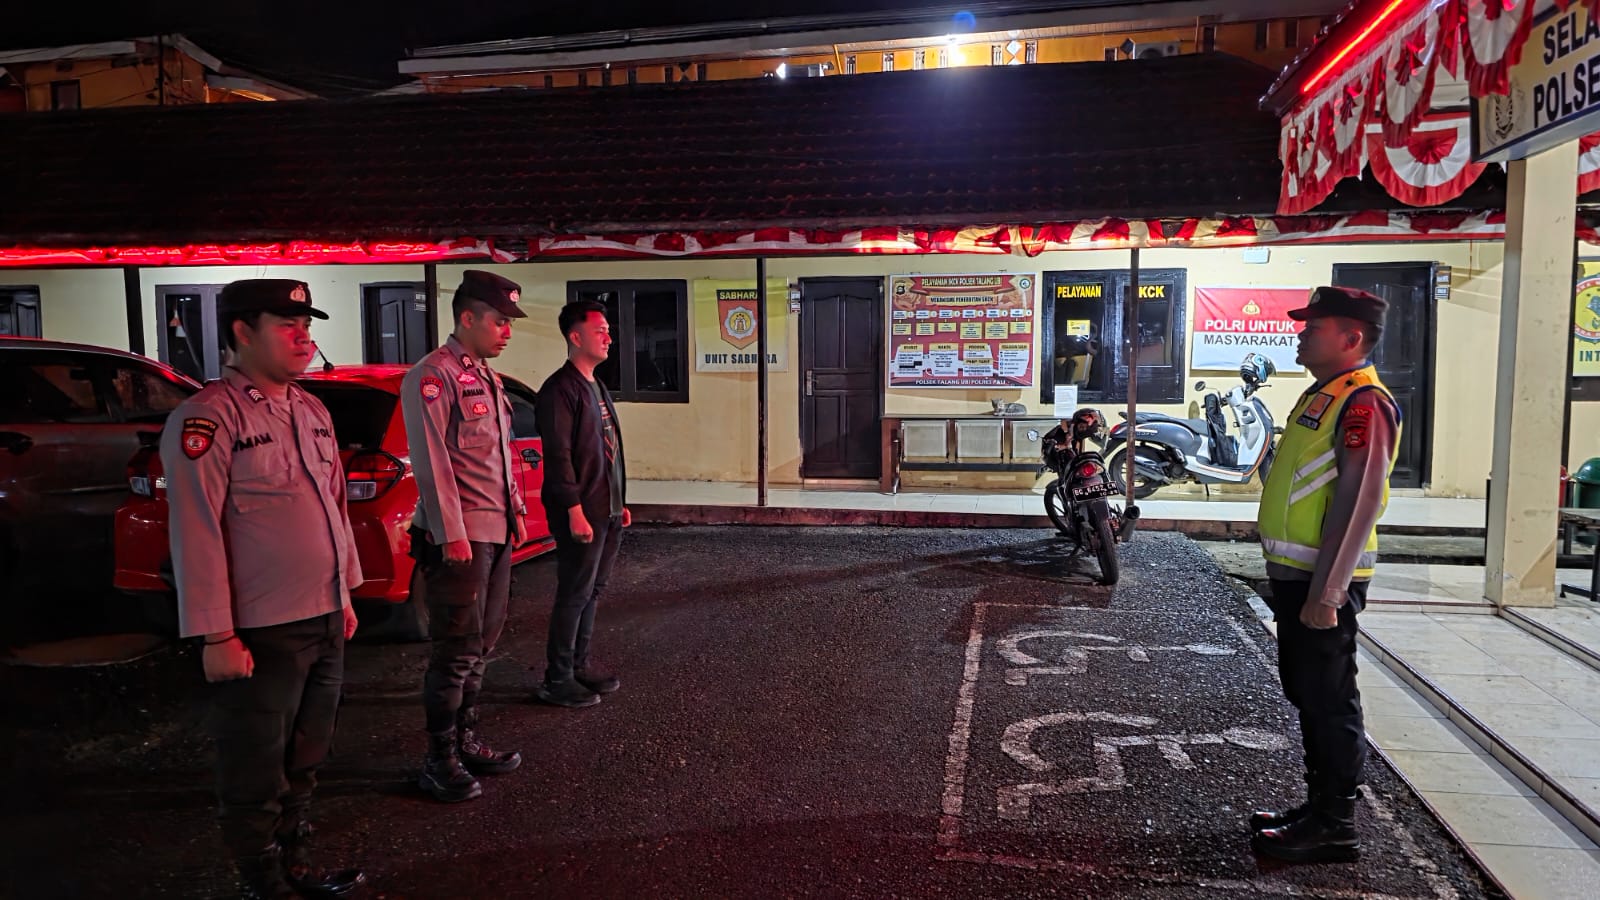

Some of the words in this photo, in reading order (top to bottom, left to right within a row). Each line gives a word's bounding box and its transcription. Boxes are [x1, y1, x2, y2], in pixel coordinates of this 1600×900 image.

[1057, 285, 1102, 298] PELAYANAN
[1139, 286, 1164, 298] KCK
[1205, 319, 1244, 331] POLRI
[1249, 320, 1295, 332] UNTUK
[1204, 334, 1296, 347] MASYARAKAT
[705, 353, 727, 364] UNIT
[731, 353, 777, 364] SABHRA
